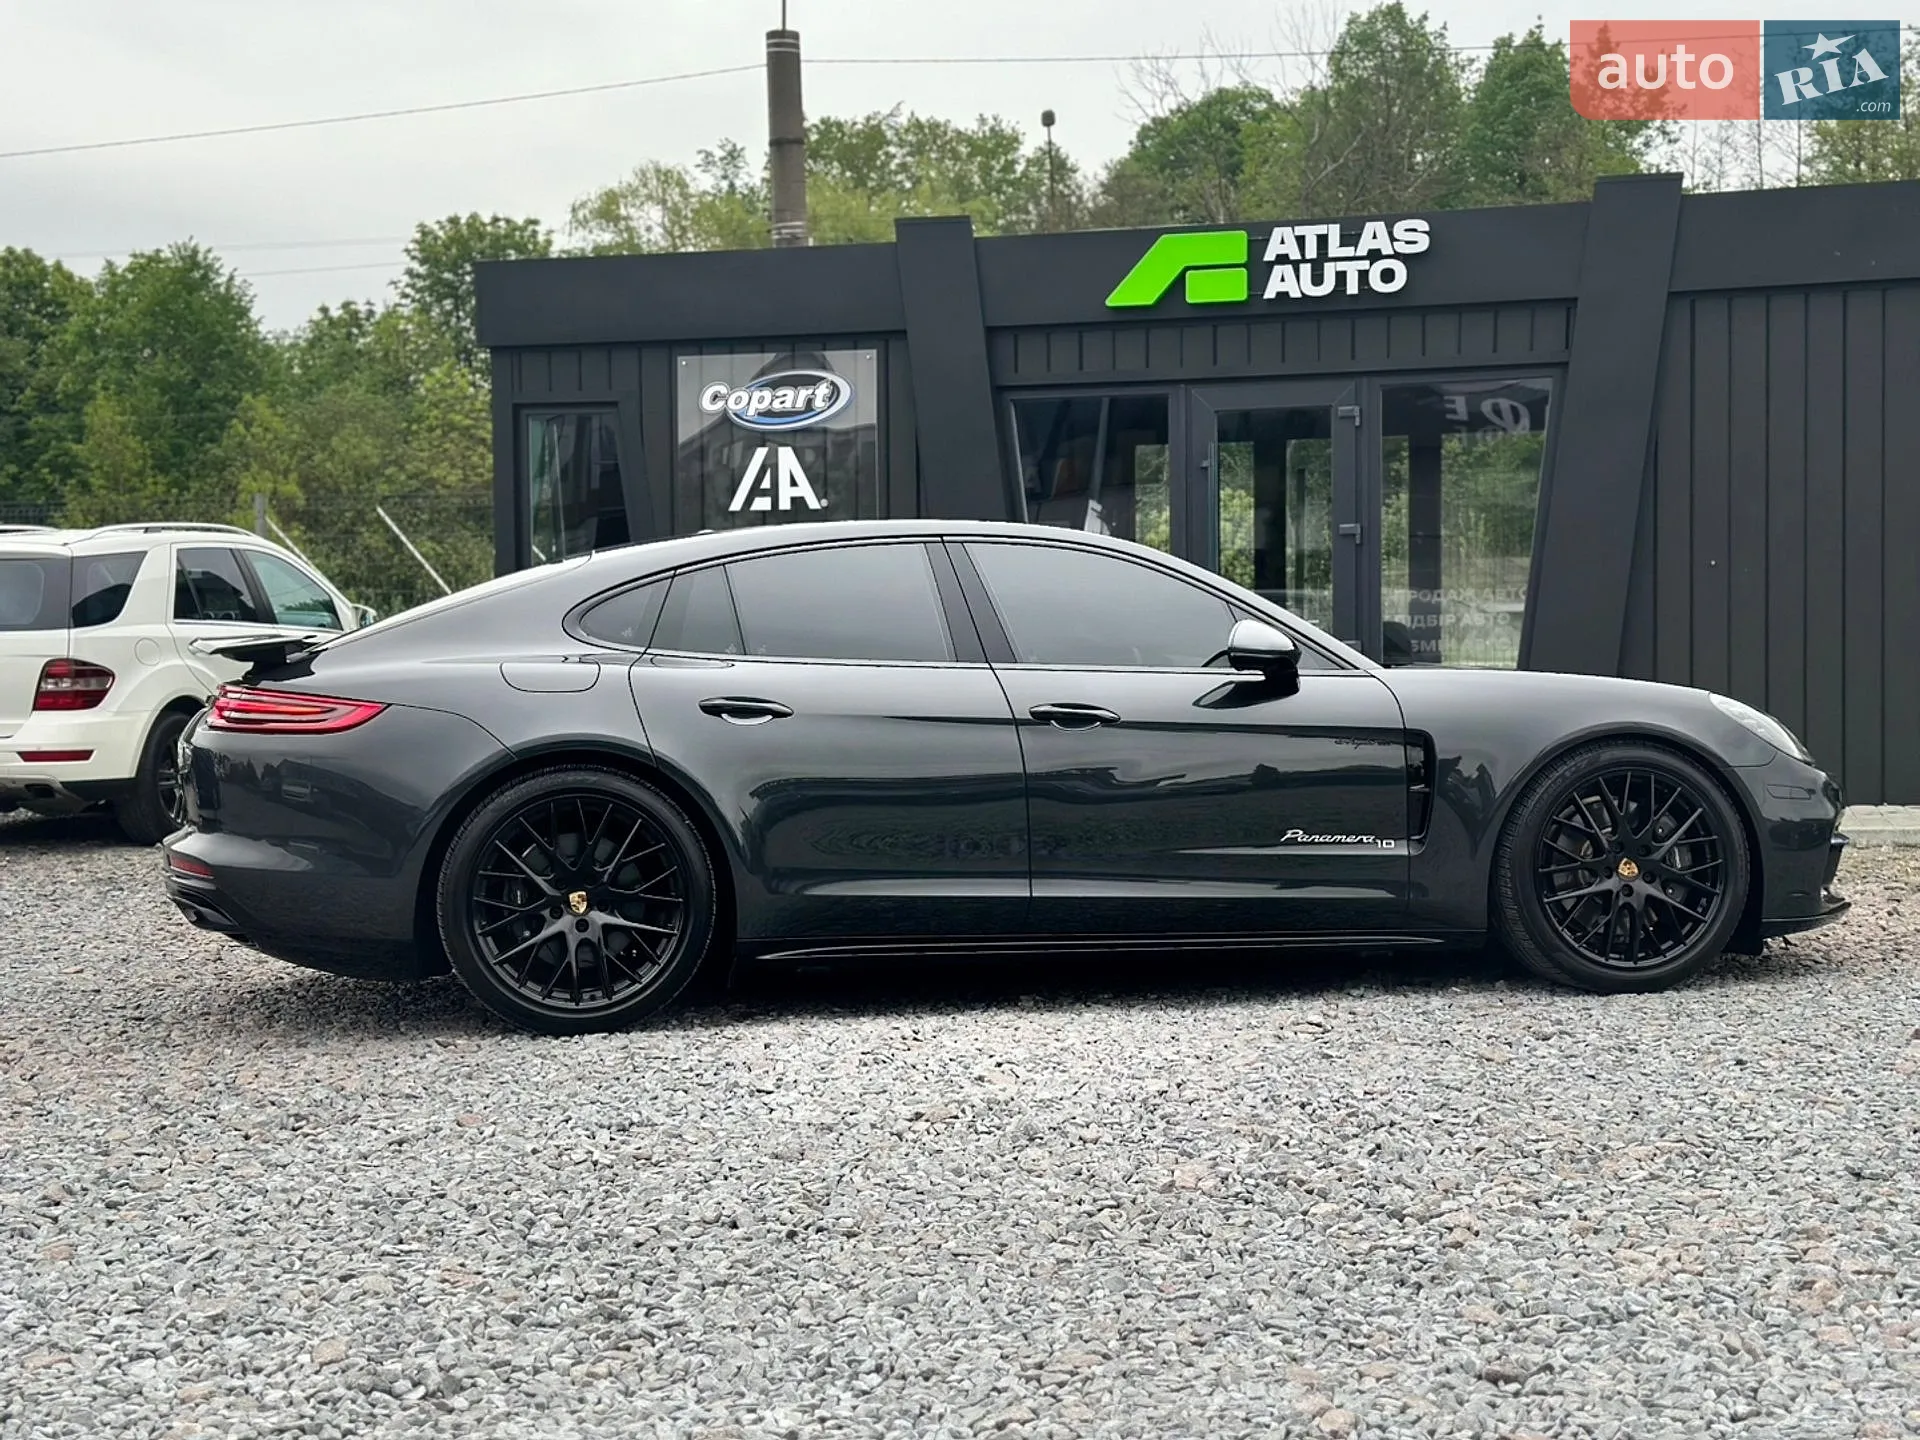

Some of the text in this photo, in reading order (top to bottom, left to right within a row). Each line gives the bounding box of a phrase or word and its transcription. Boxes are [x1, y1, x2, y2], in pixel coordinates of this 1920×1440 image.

[1263, 219, 1431, 262] ATLAS
[1263, 258, 1408, 300] AUTO
[700, 378, 833, 417] Copart
[1280, 829, 1376, 843] Panamera
